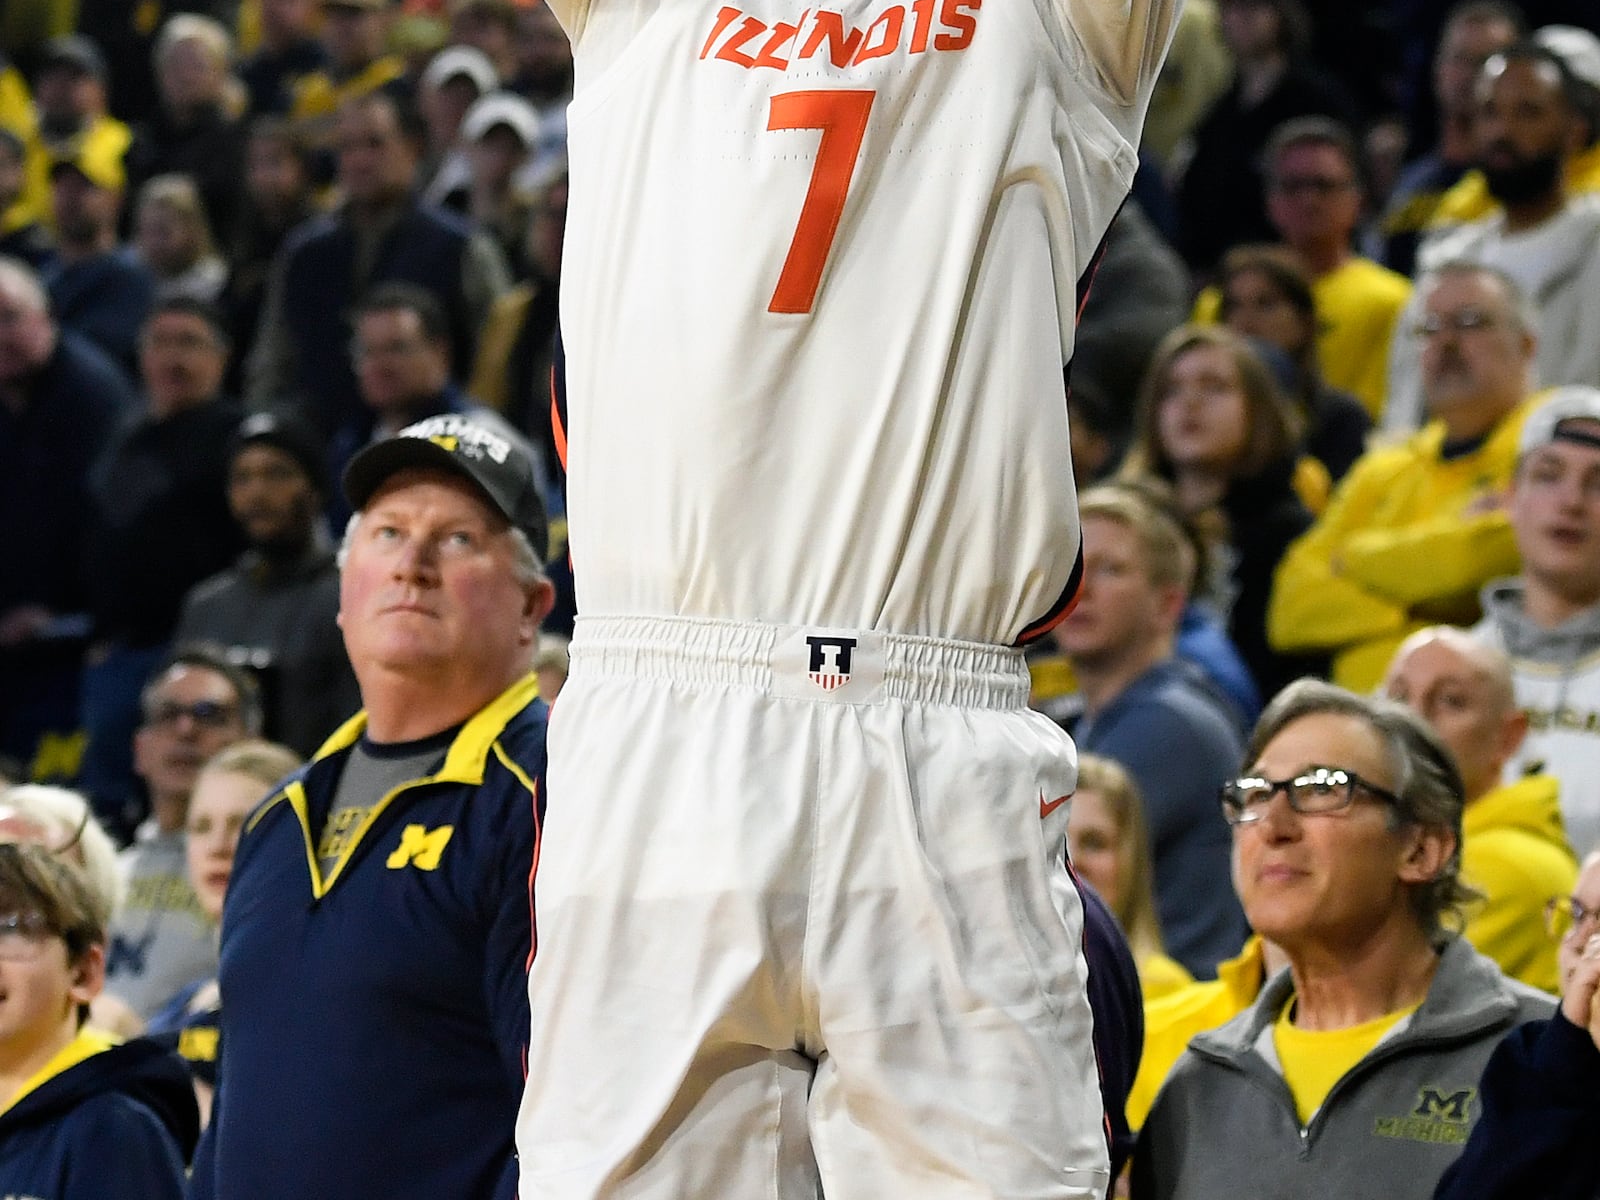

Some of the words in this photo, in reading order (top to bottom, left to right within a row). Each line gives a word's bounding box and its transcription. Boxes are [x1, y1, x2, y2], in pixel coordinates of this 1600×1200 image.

[767, 90, 876, 313] 7
[386, 824, 455, 871] M
[1412, 1084, 1478, 1124] M
